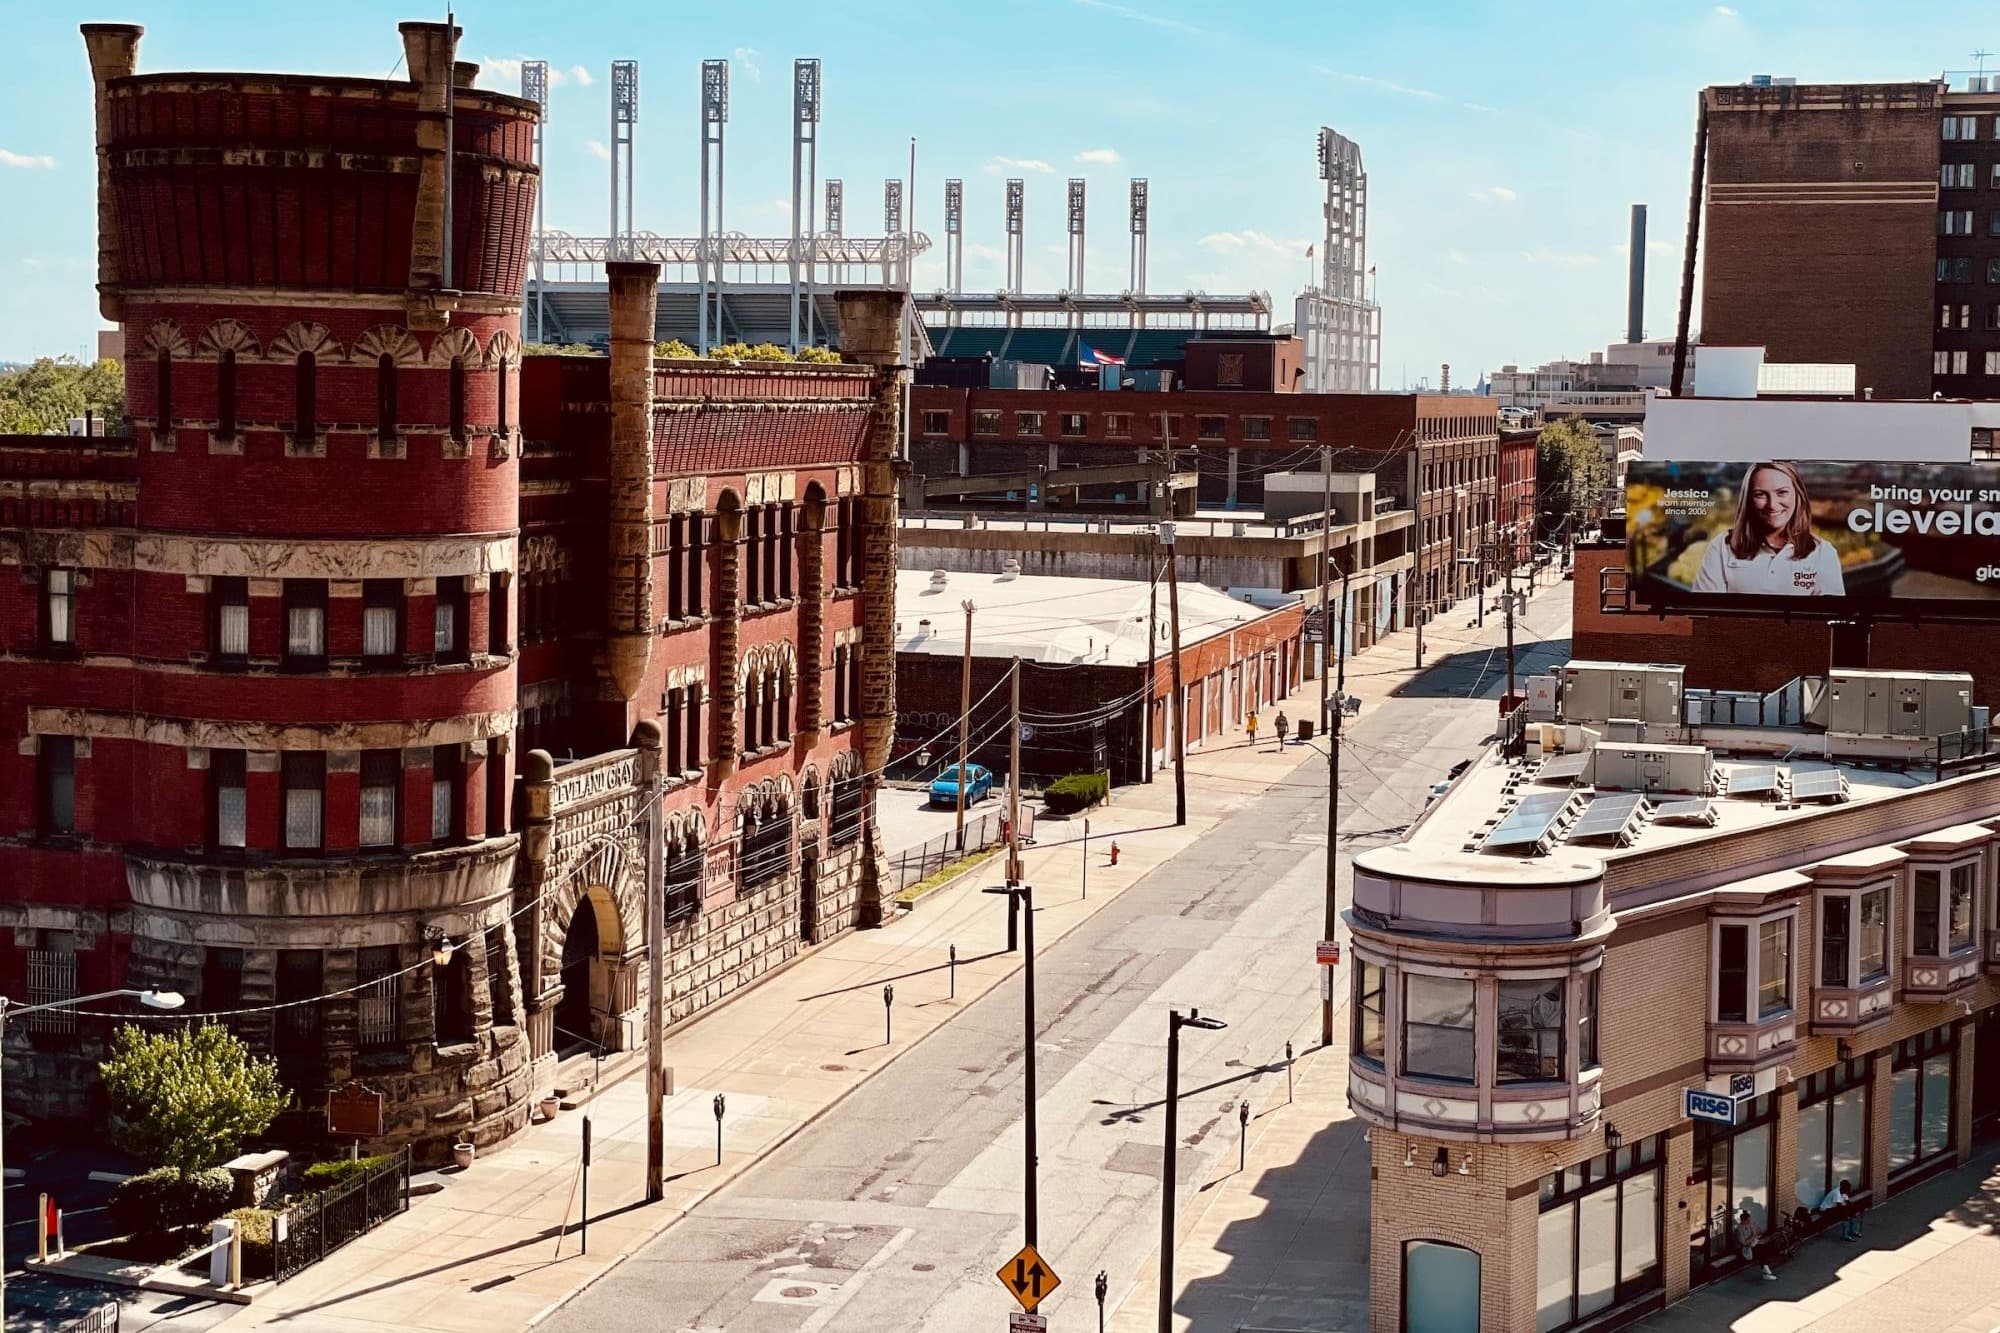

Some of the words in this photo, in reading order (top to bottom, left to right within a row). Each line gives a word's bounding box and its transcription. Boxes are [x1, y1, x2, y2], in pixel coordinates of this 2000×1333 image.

[1663, 488, 1709, 498] Jessica
[1870, 484, 1922, 505] bring
[1929, 489, 1973, 504] your
[1657, 499, 1678, 507] team
[1680, 499, 1716, 507] member
[1847, 502, 2000, 536] clevela
